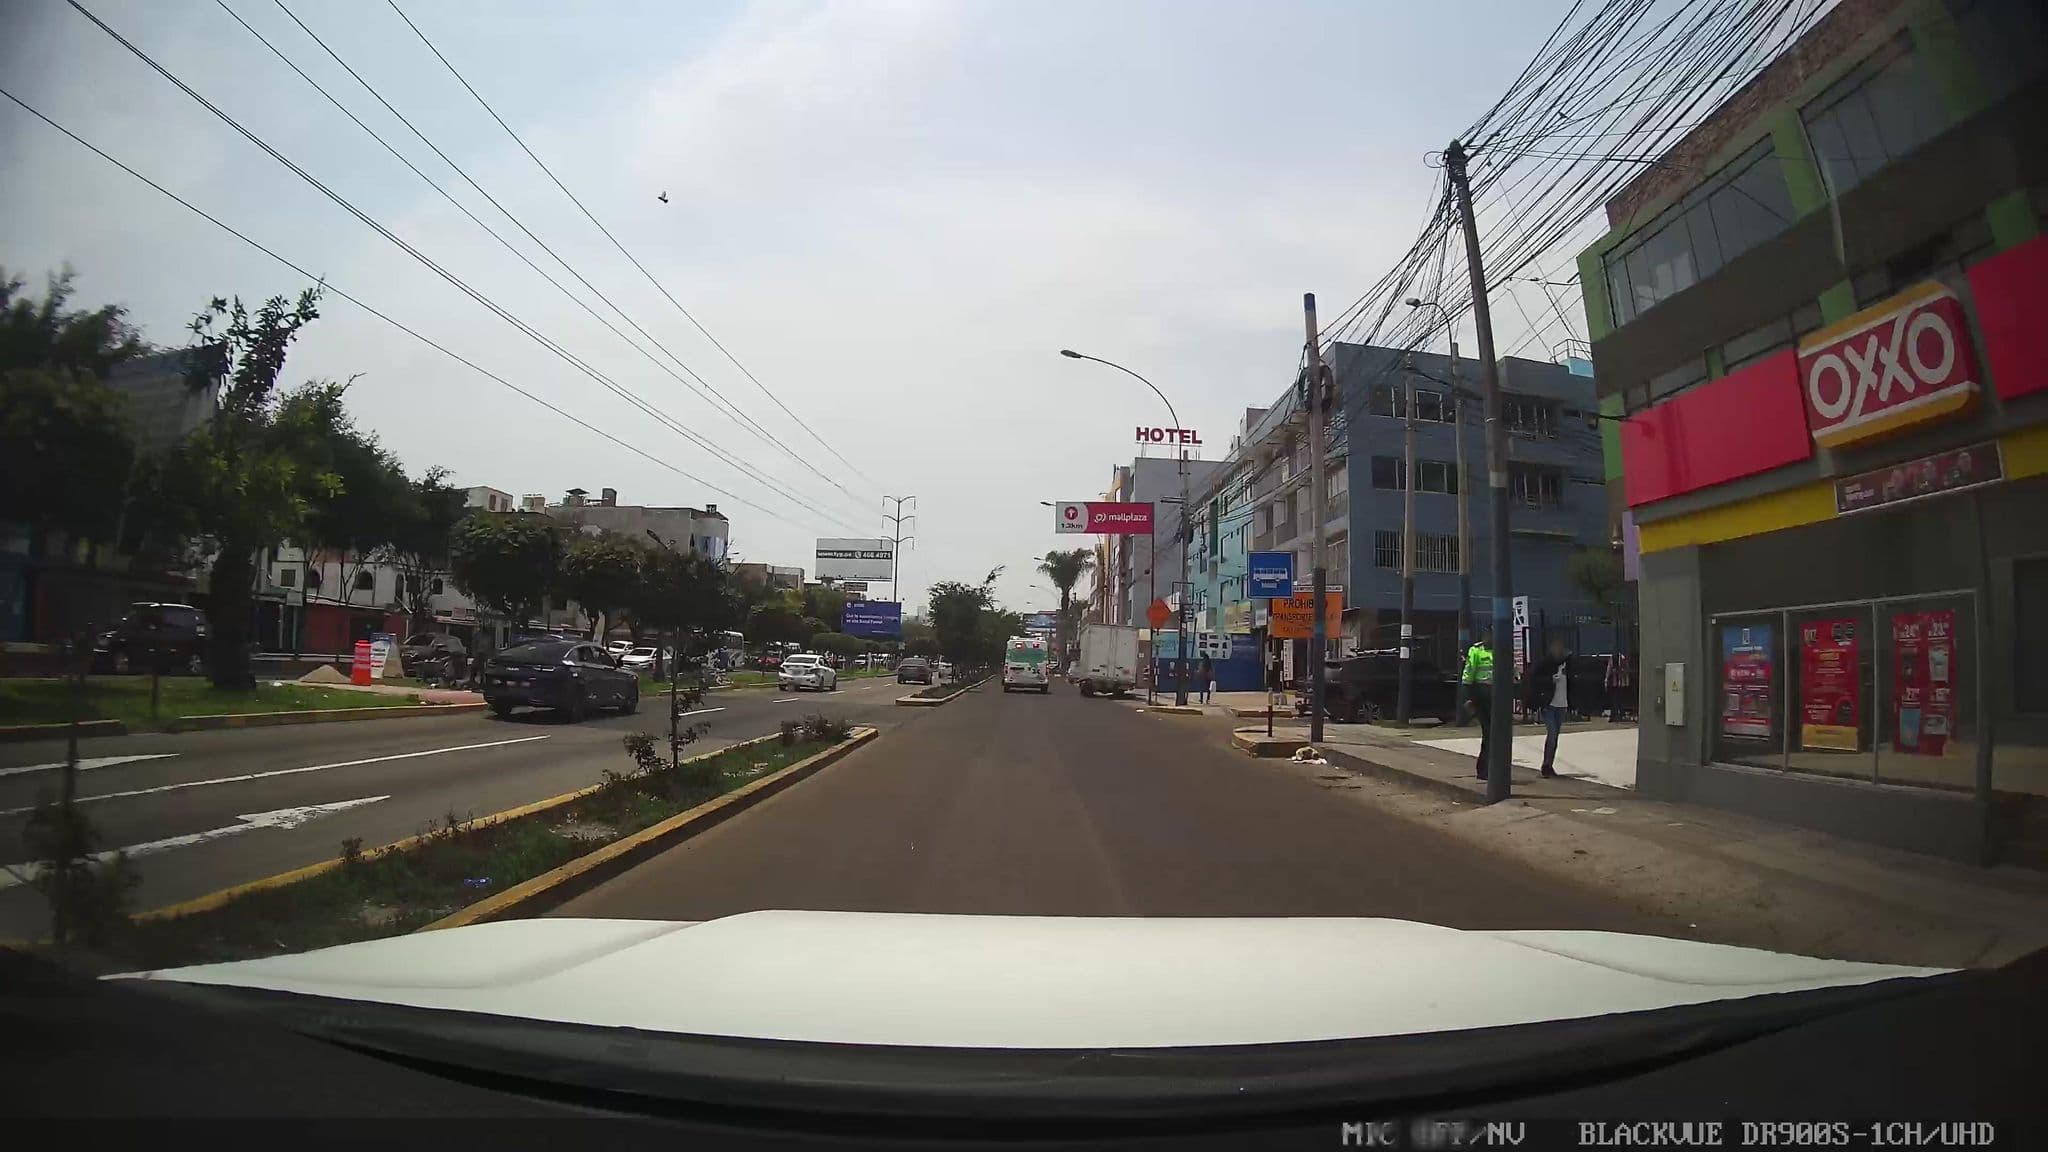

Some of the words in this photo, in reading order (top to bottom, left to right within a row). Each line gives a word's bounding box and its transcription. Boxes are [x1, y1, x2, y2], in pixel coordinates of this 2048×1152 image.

[1809, 309, 1954, 424] OXXO
[1136, 427, 1203, 444] HOTEL
[1109, 512, 1148, 523] mallplaza
[1283, 599, 1327, 609] PROHIB
